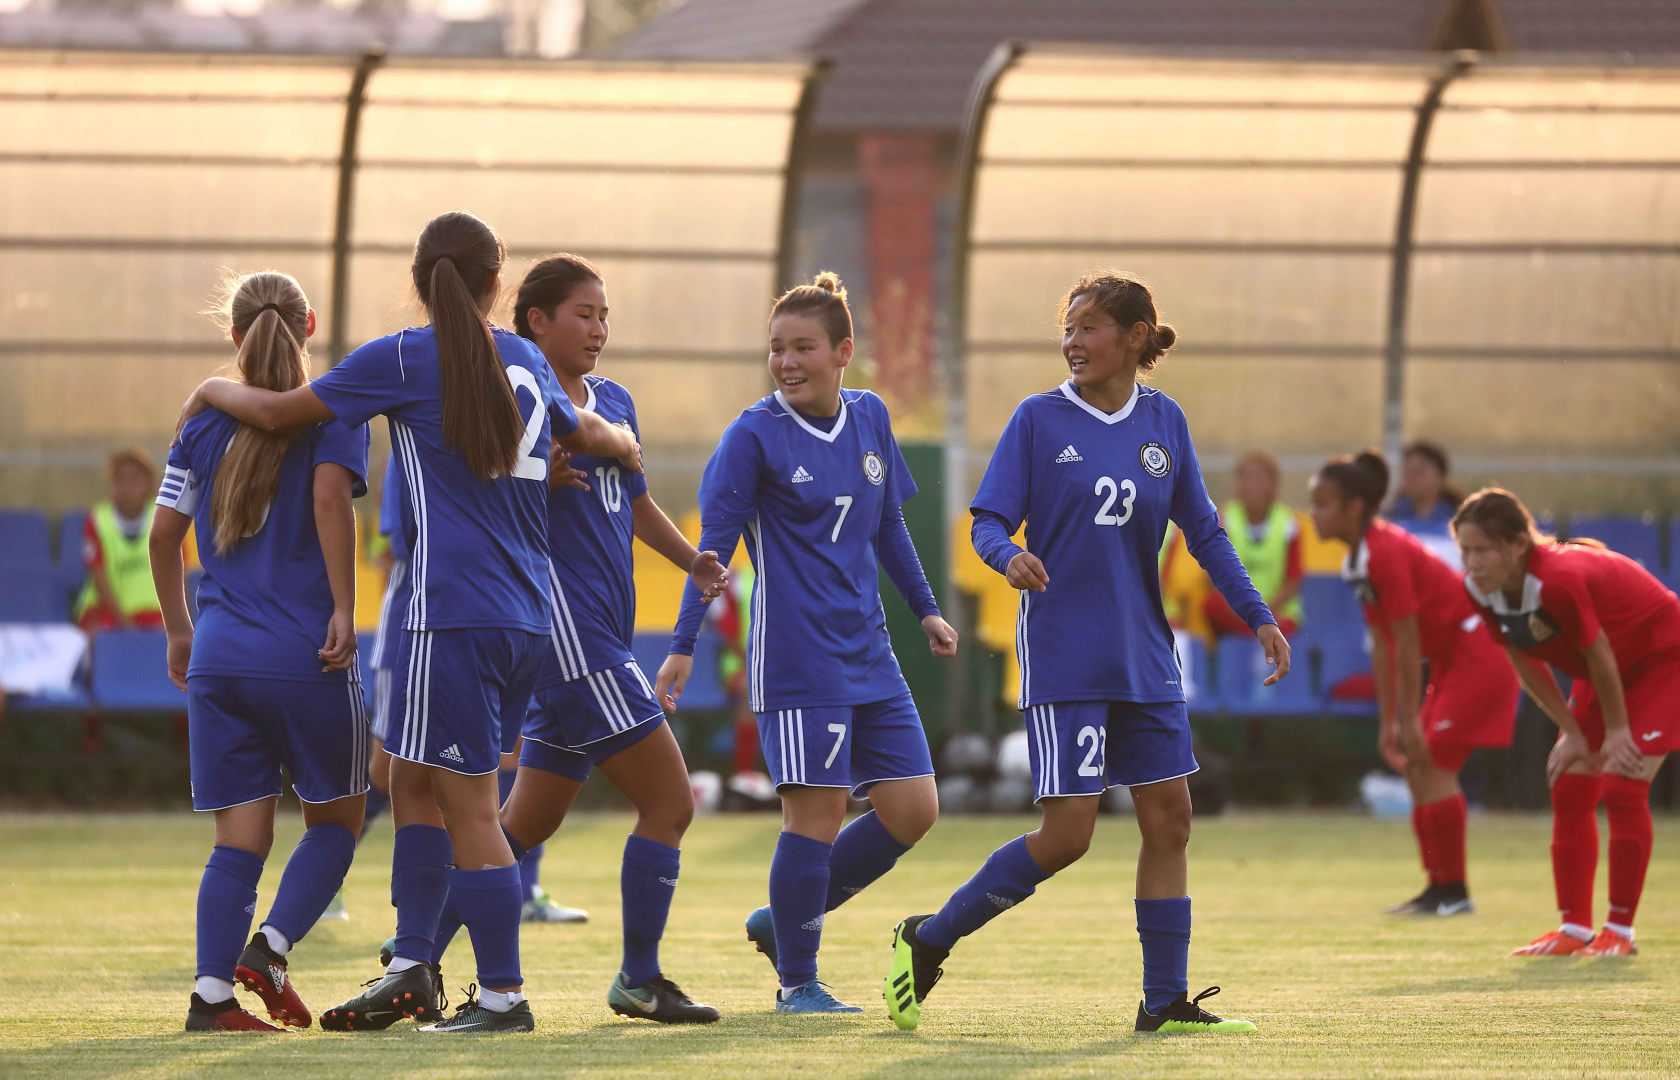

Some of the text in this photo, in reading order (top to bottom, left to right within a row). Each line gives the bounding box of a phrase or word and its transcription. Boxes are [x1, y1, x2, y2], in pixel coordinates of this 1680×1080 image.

[489, 364, 547, 482] 2
[1055, 455, 1083, 464] adidas
[595, 465, 622, 514] 10
[1094, 475, 1137, 527] 23
[831, 495, 853, 543] 7
[439, 751, 465, 764] adidas
[824, 722, 847, 770] 7
[268, 964, 284, 994] adidas
